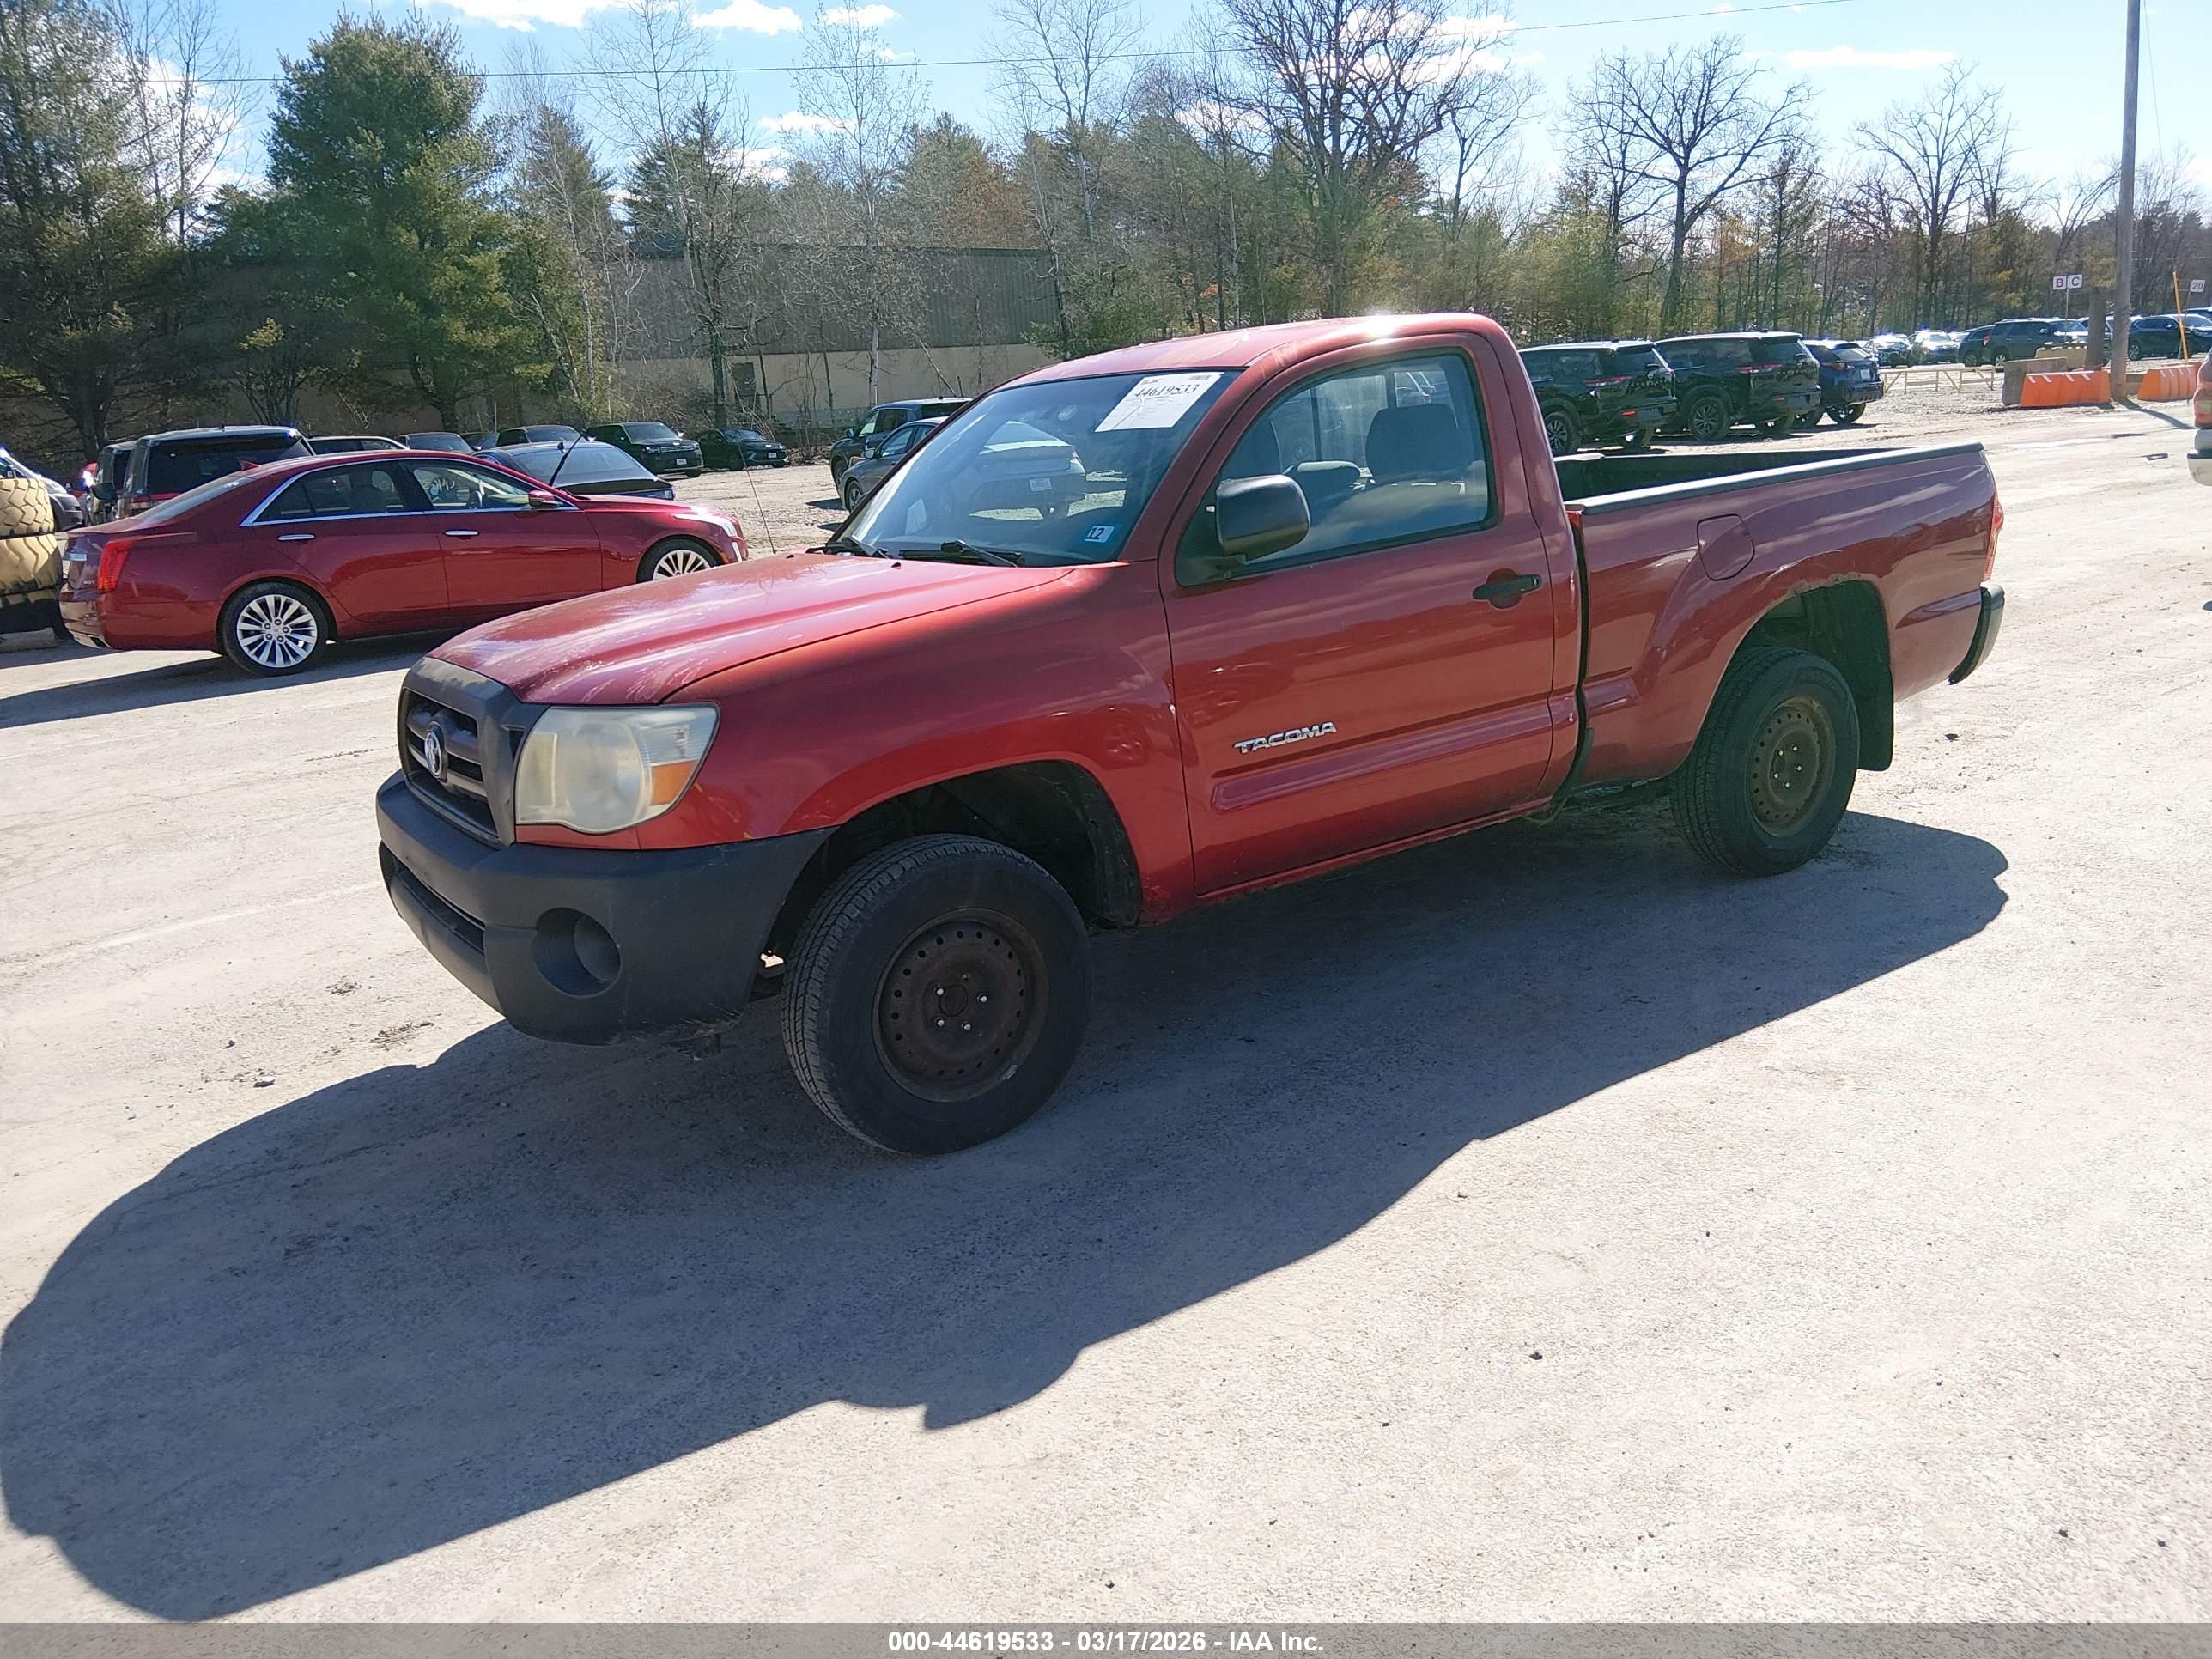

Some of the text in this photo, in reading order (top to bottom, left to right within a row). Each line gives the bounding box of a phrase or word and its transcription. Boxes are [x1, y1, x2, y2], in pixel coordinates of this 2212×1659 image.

[2056, 276, 2081, 288] B C
[2191, 282, 2203, 290] 20
[1086, 526, 1106, 540] 12
[1233, 720, 1338, 755] TACOMA
